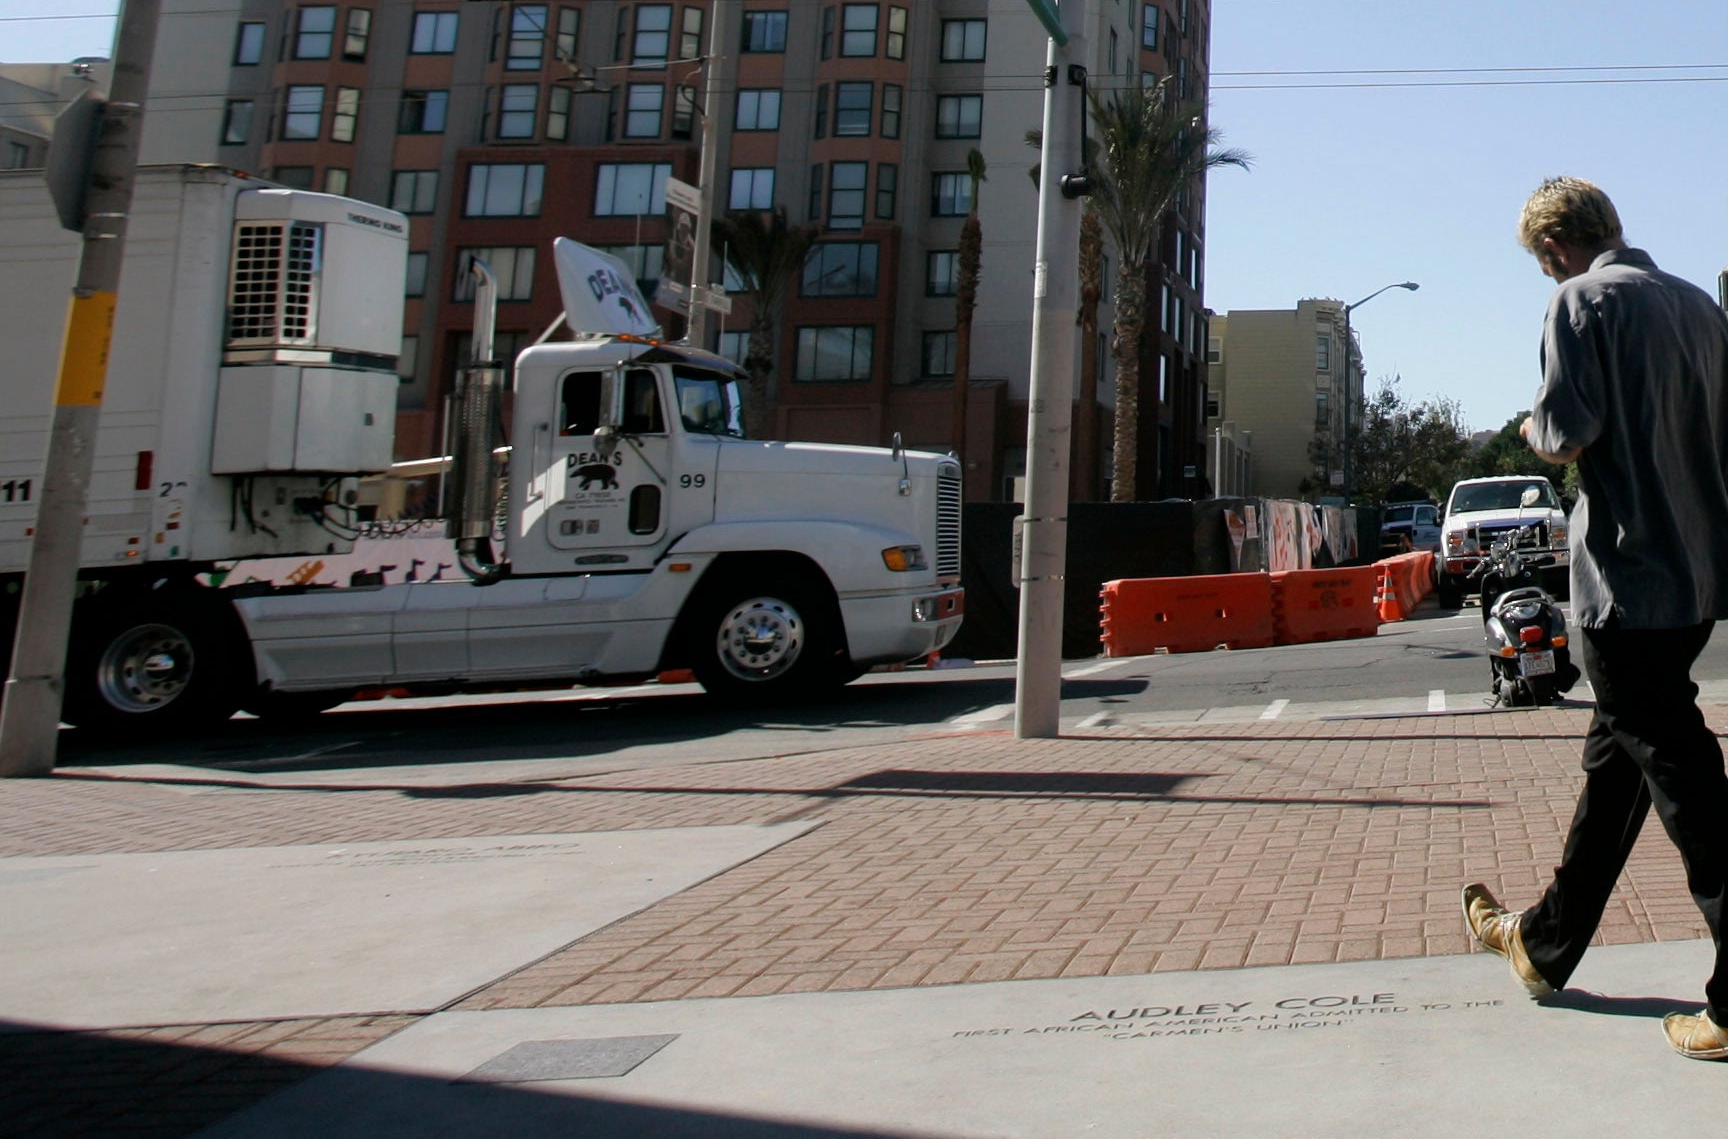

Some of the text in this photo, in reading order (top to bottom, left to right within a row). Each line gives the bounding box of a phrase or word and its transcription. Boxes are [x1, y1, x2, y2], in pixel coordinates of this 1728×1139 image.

[679, 473, 706, 489] 99
[952, 999, 1505, 1038] FIRST AFRICAN AMERICAN ADMITTED TO THE
[1070, 993, 1396, 1022] AUDLEY COLE
[1103, 1018, 1355, 1040] "CARMEN'S UNION"
